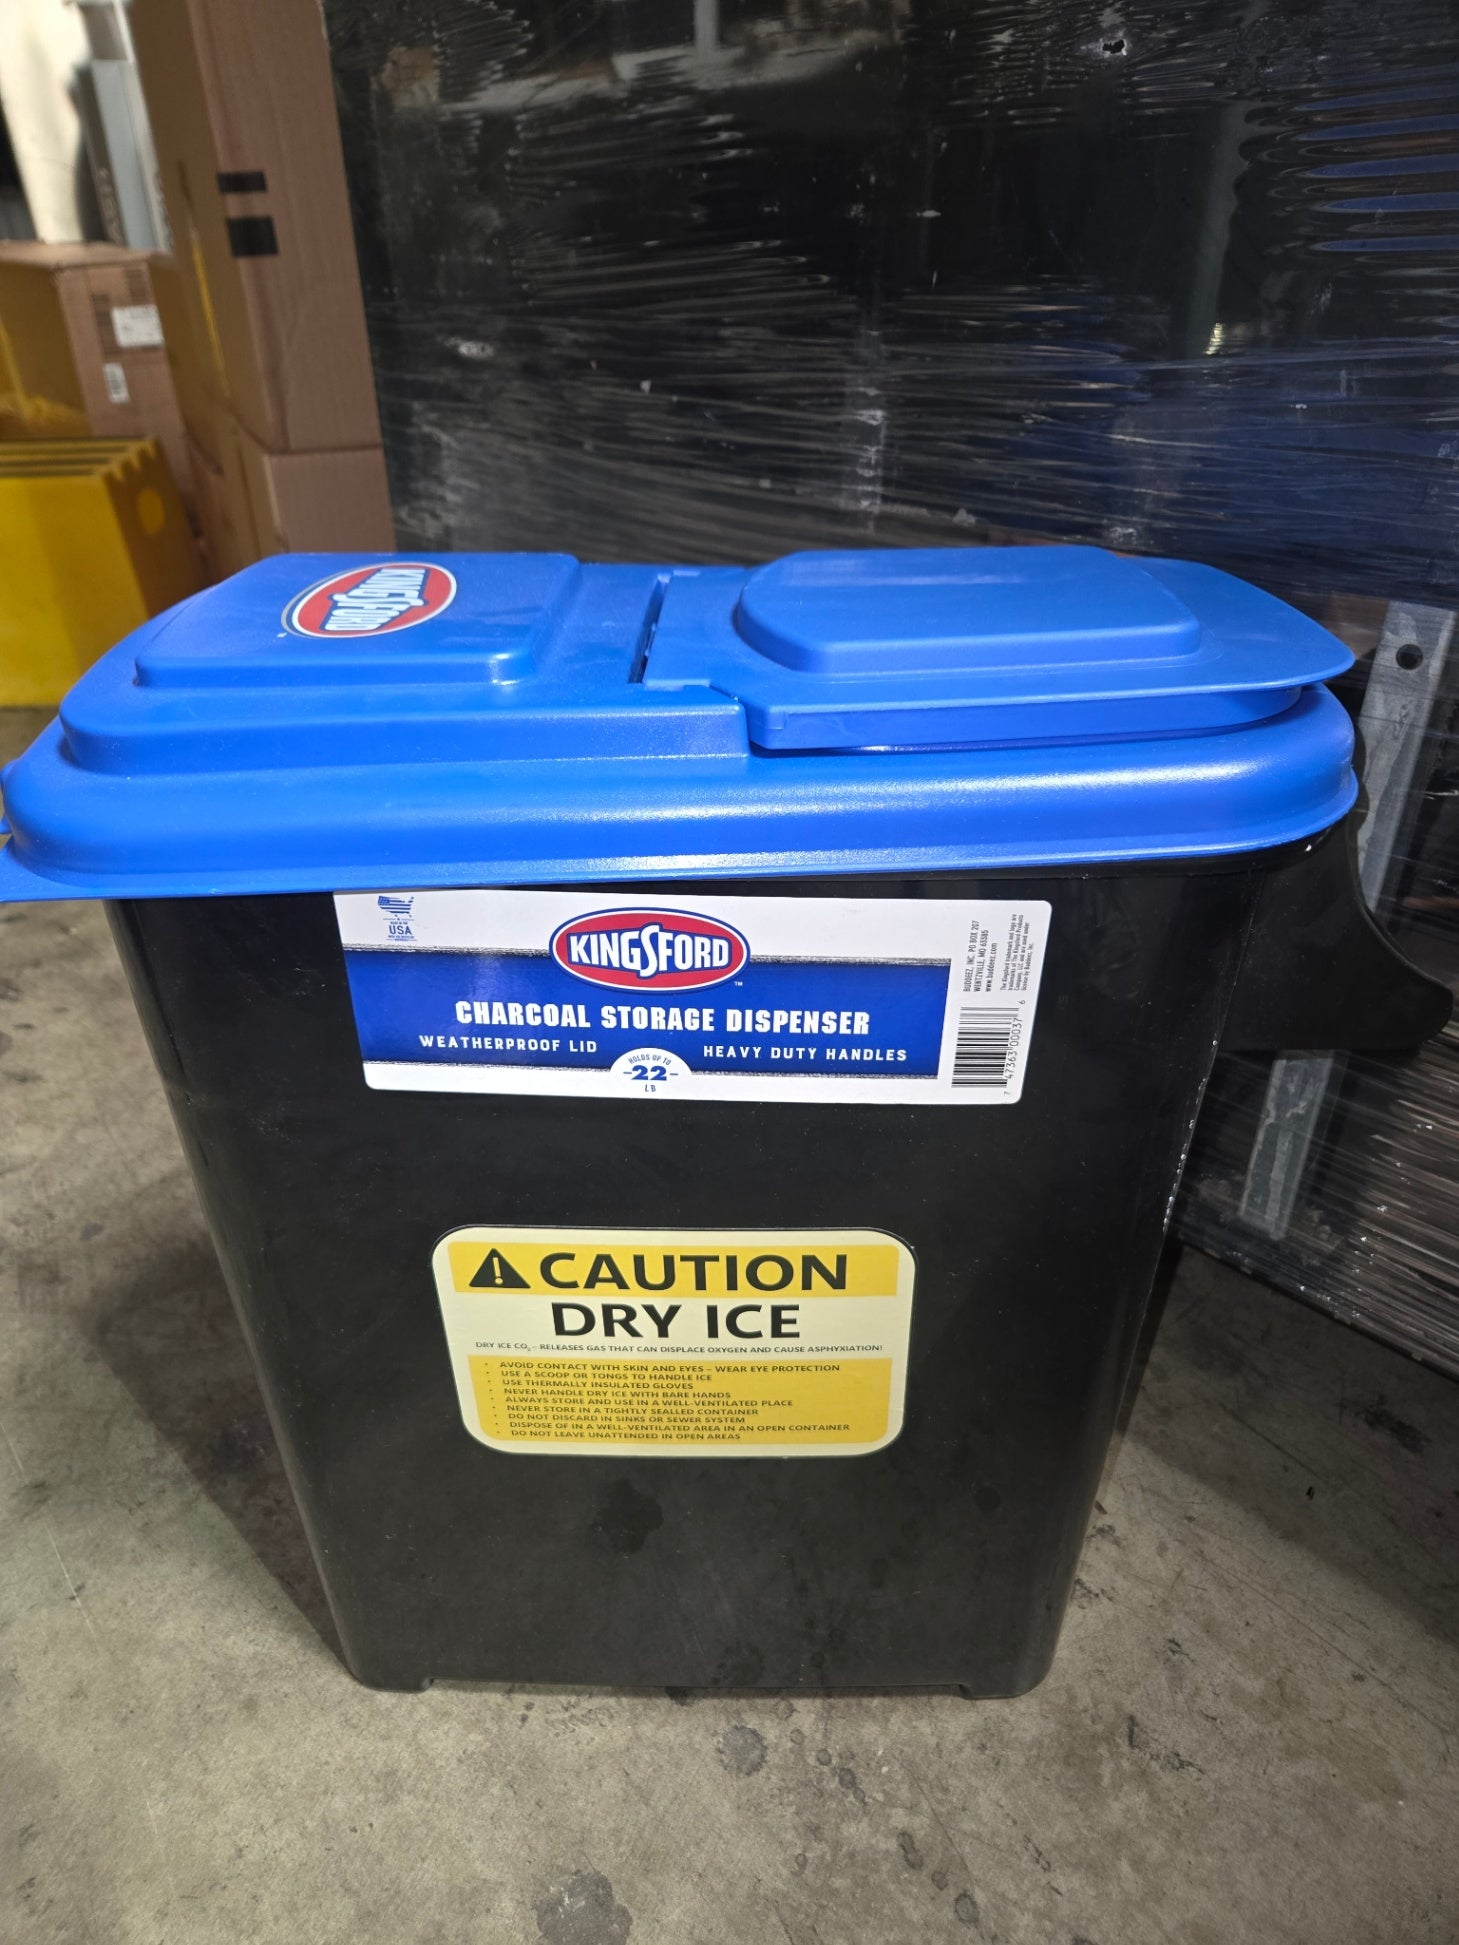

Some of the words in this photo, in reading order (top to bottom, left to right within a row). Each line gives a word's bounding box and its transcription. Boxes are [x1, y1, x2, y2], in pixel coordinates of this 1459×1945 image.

[325, 568, 425, 631] KINGSFORD
[389, 925, 412, 935] USA
[971, 920, 979, 930] 207
[969, 932, 978, 943] BOX
[569, 925, 729, 978] KINGSFORD
[968, 944, 977, 953] PO
[978, 948, 986, 957] MO
[985, 943, 998, 992] www.buddeez.com
[455, 1001, 590, 1028] CHARCOAL
[601, 1006, 714, 1032] STORAGE
[726, 1009, 870, 1035] DISPENSER
[1009, 1017, 1022, 1047] 00037
[419, 1035, 561, 1052] WEATHERPROOF
[569, 1039, 597, 1053] LID
[628, 1054, 650, 1064] HOLDS
[652, 1054, 662, 1062] UP
[662, 1057, 672, 1065] TO
[703, 1045, 762, 1059] HEAVY
[771, 1047, 817, 1060] DUTY
[826, 1048, 907, 1062] HANDLES
[631, 1065, 667, 1081] 22
[1004, 1051, 1017, 1079] 47363
[540, 1252, 847, 1291] CAUTION
[552, 1302, 682, 1338] DRY
[706, 1304, 800, 1339] ICE
[500, 1361, 534, 1369] AVOID
[537, 1362, 587, 1370] CONTACT
[591, 1381, 650, 1389] INSULATED
